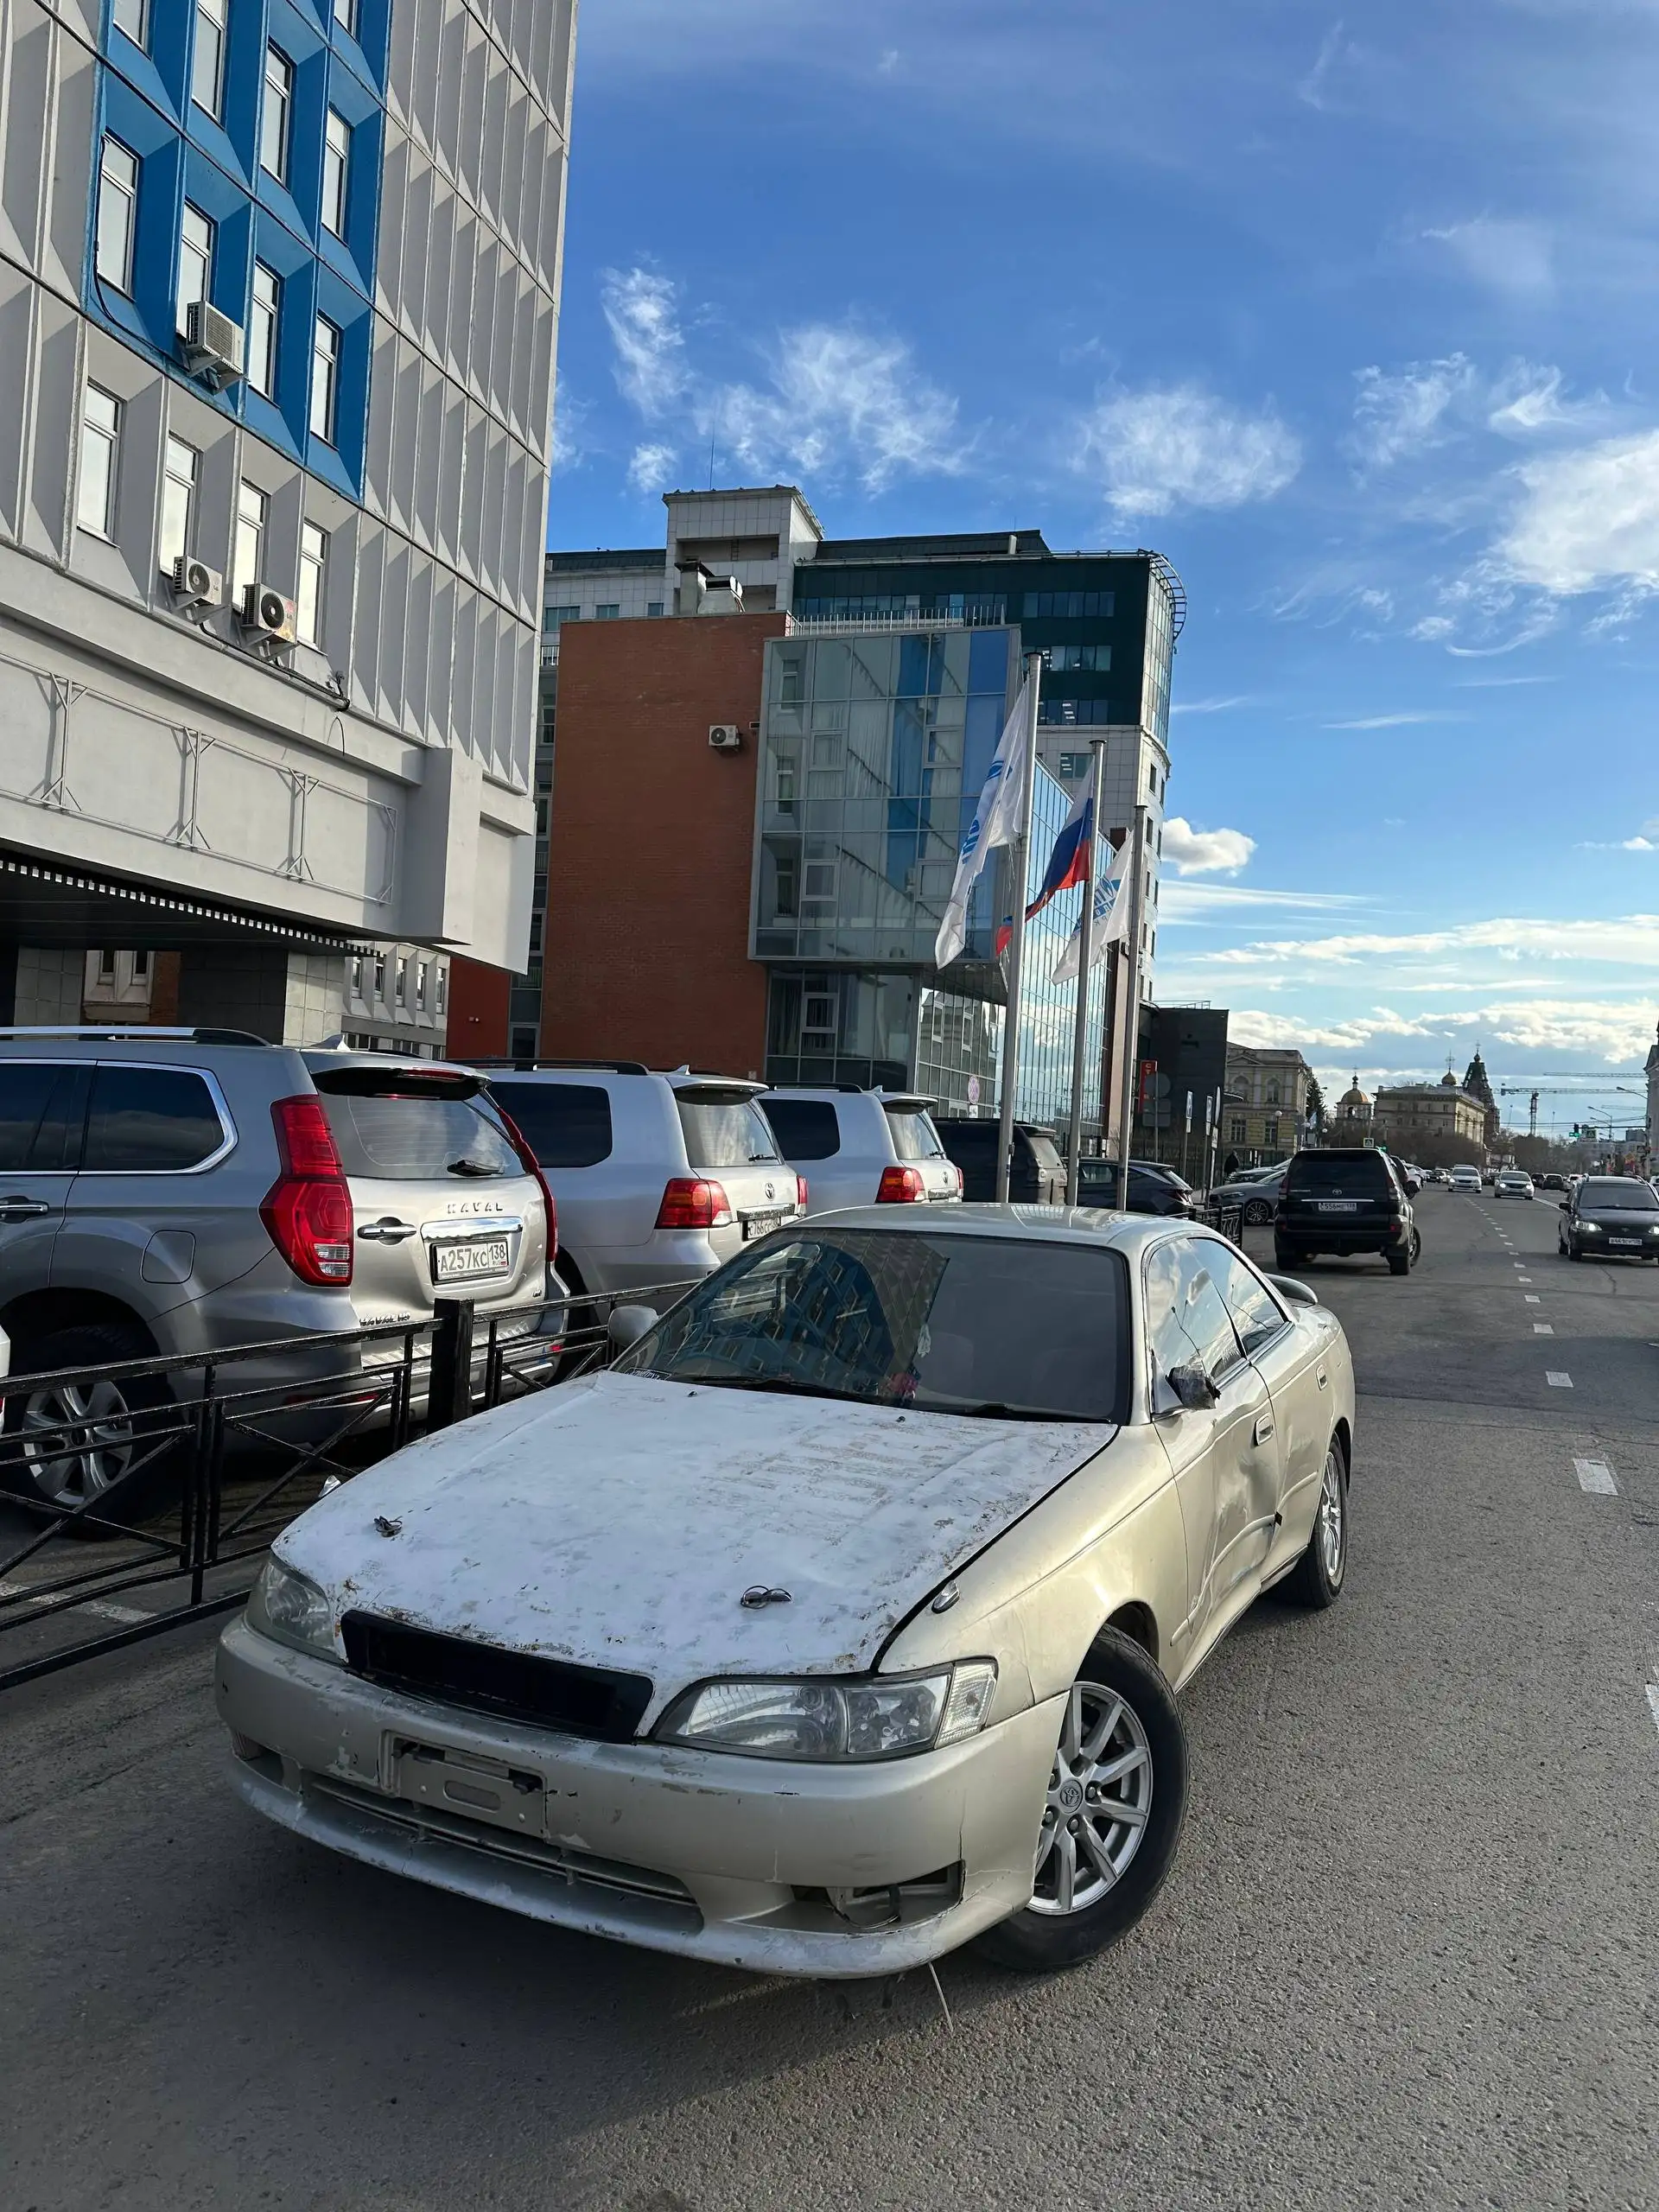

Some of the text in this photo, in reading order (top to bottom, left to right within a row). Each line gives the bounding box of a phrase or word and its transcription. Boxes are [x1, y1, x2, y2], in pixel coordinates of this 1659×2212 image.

[447, 1202, 504, 1214] HAVAL
[441, 1244, 505, 1272] А257КС 138
